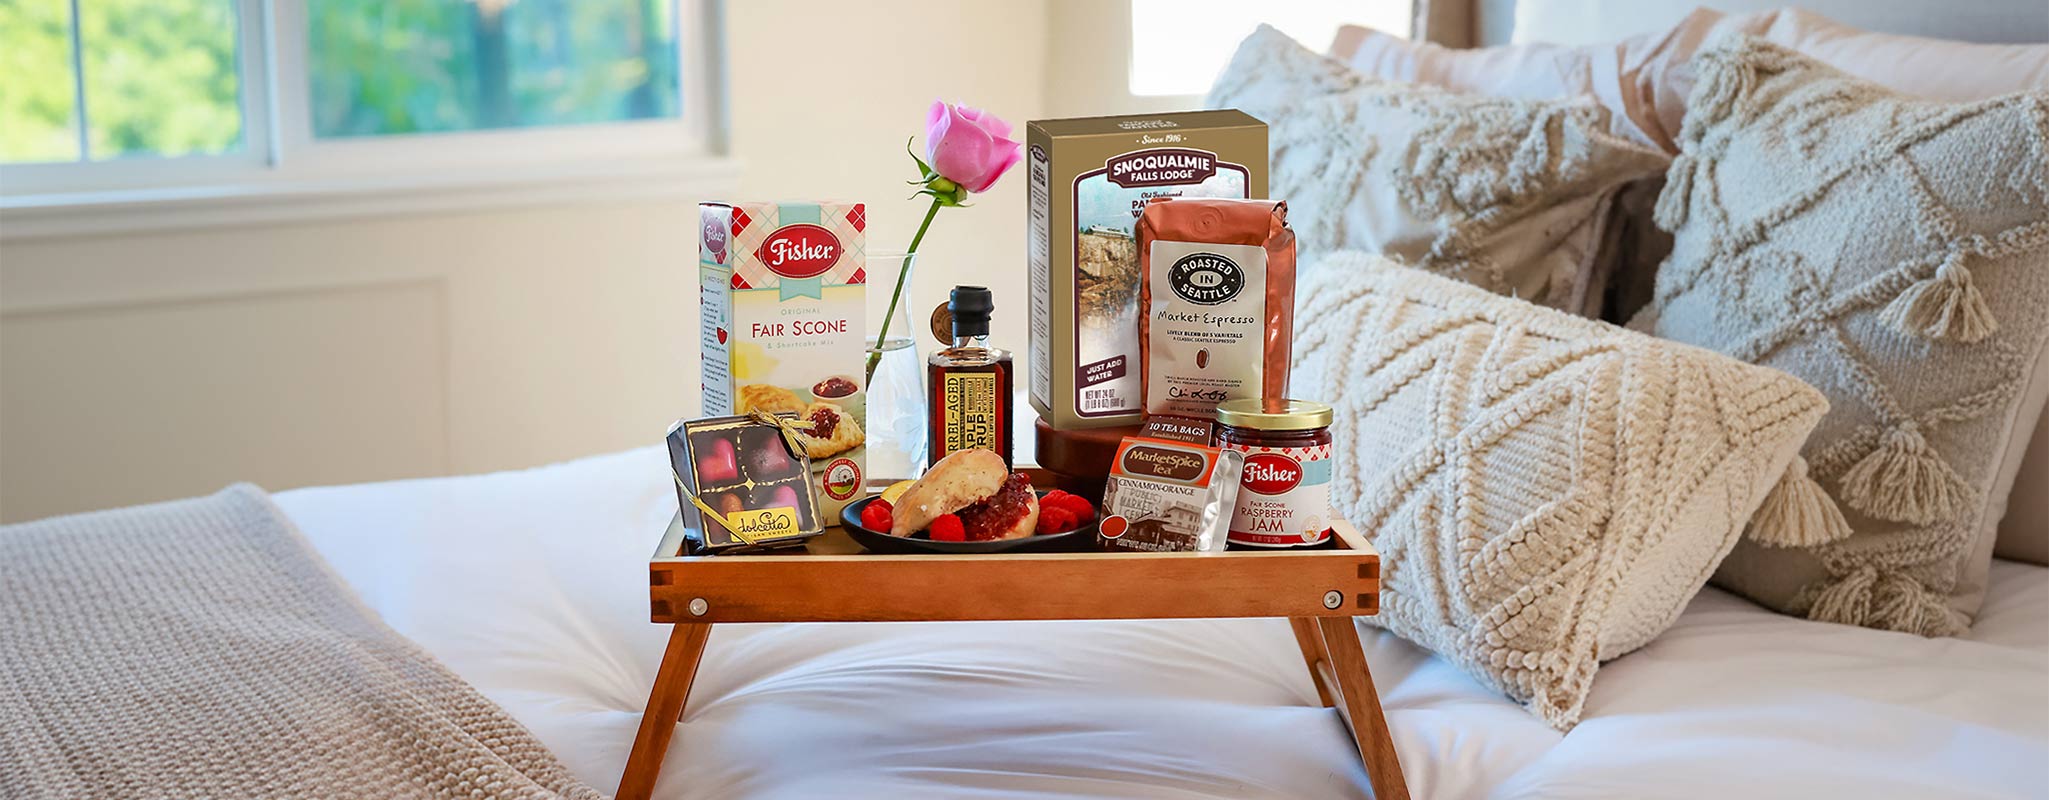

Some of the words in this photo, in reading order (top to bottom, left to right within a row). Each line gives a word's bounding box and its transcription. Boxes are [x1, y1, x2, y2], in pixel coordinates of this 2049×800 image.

[1142, 135, 1163, 144] Since
[1165, 134, 1181, 143] 1916
[1113, 155, 1210, 176] SNOQUALMIE
[1131, 172, 1158, 182] FALLS
[1141, 191, 1152, 199] Old
[1153, 191, 1183, 199] Fashioned
[705, 225, 725, 243] Fisher
[770, 237, 834, 266] Fisher
[1180, 258, 1233, 276] ROASTED
[1200, 275, 1214, 284] IN
[1180, 283, 1231, 300] SEATTLE
[781, 308, 821, 316] ORIGINAL
[1158, 311, 1200, 323] Market
[1203, 313, 1255, 327] Espresso
[752, 323, 784, 338] FAIR
[792, 320, 847, 336] SCONE
[1087, 364, 1105, 375] JUST
[1106, 359, 1122, 369] ADD
[1087, 370, 1112, 382] WATER
[948, 377, 959, 451] RREL-AGED
[967, 414, 976, 449] APLE
[977, 414, 986, 449] RUP
[1149, 422, 1160, 430] 10
[1161, 423, 1177, 433] TEA
[1180, 426, 1205, 436] BAGS
[1151, 431, 1181, 440] Established
[1130, 450, 1200, 468] MarketSpice
[1153, 464, 1172, 475] Tea
[1244, 462, 1297, 483] Fisher
[1118, 478, 1195, 496] CINNAMON-ORANGE
[1241, 507, 1293, 518] RASPBERRY
[738, 511, 791, 532] dolcetta
[1249, 518, 1284, 532] JAM
